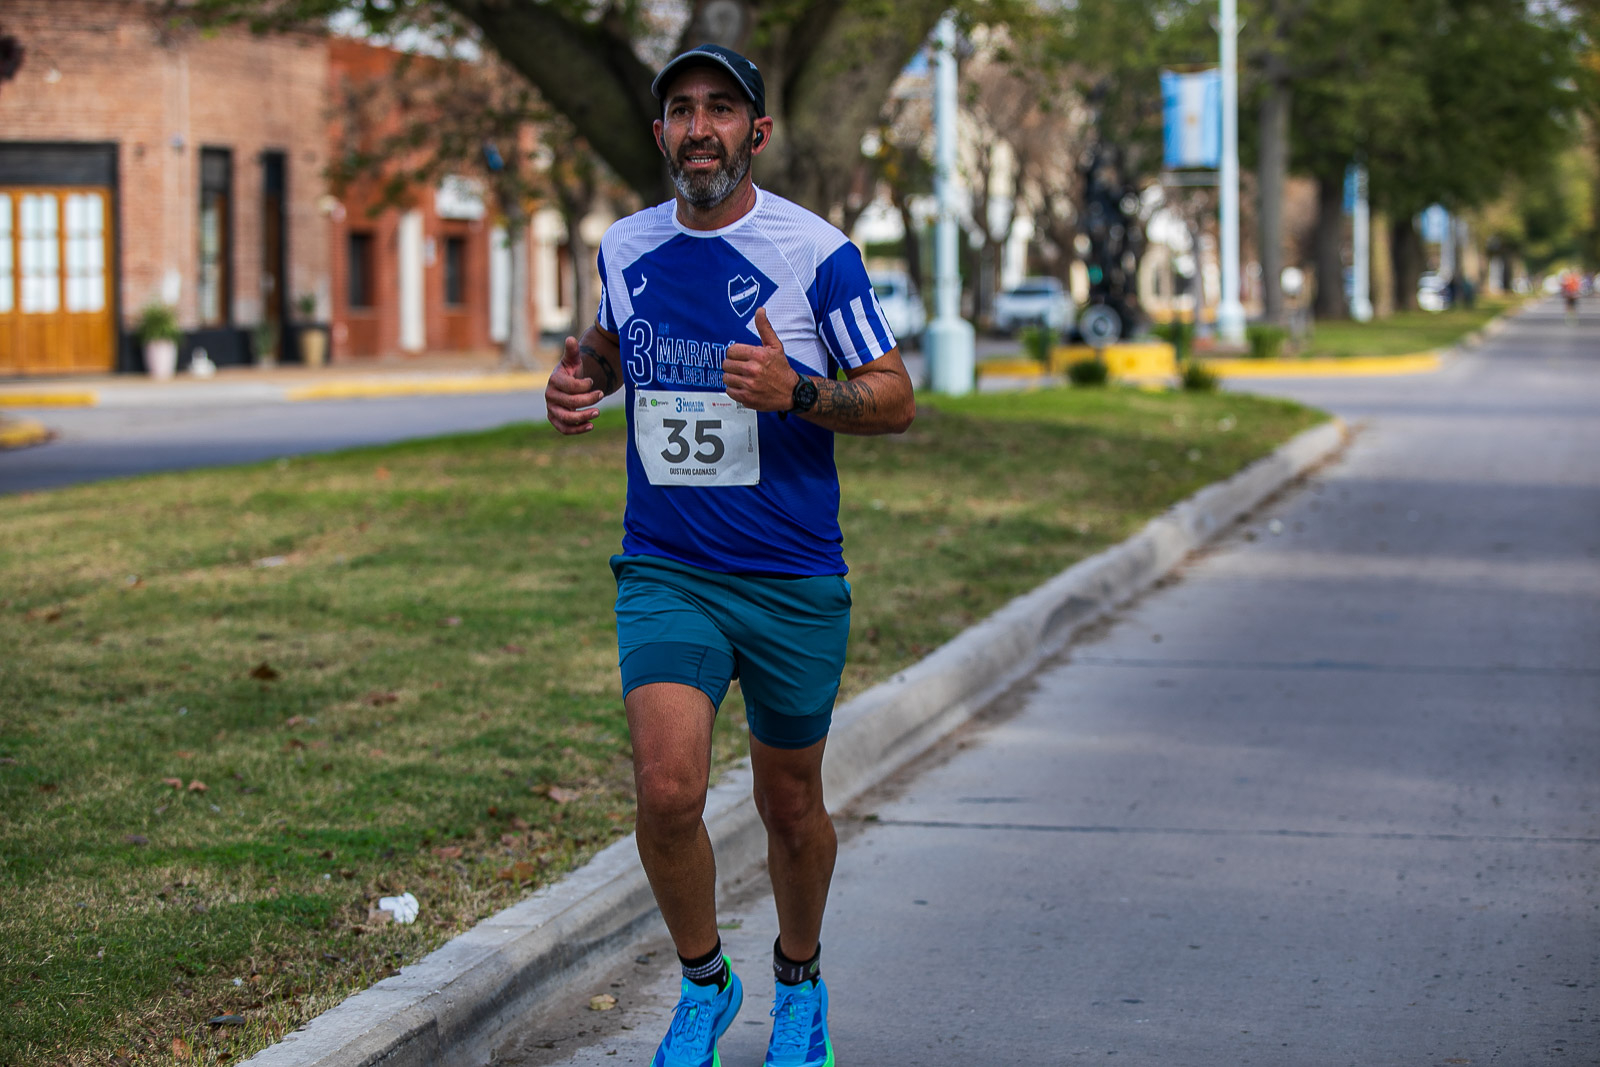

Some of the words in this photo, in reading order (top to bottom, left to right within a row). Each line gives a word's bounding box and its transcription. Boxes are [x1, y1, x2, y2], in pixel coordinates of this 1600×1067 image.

[627, 318, 653, 386] 3
[656, 336, 736, 370] MARAT
[661, 418, 725, 464] 35
[669, 467, 691, 475] GUSTAVO
